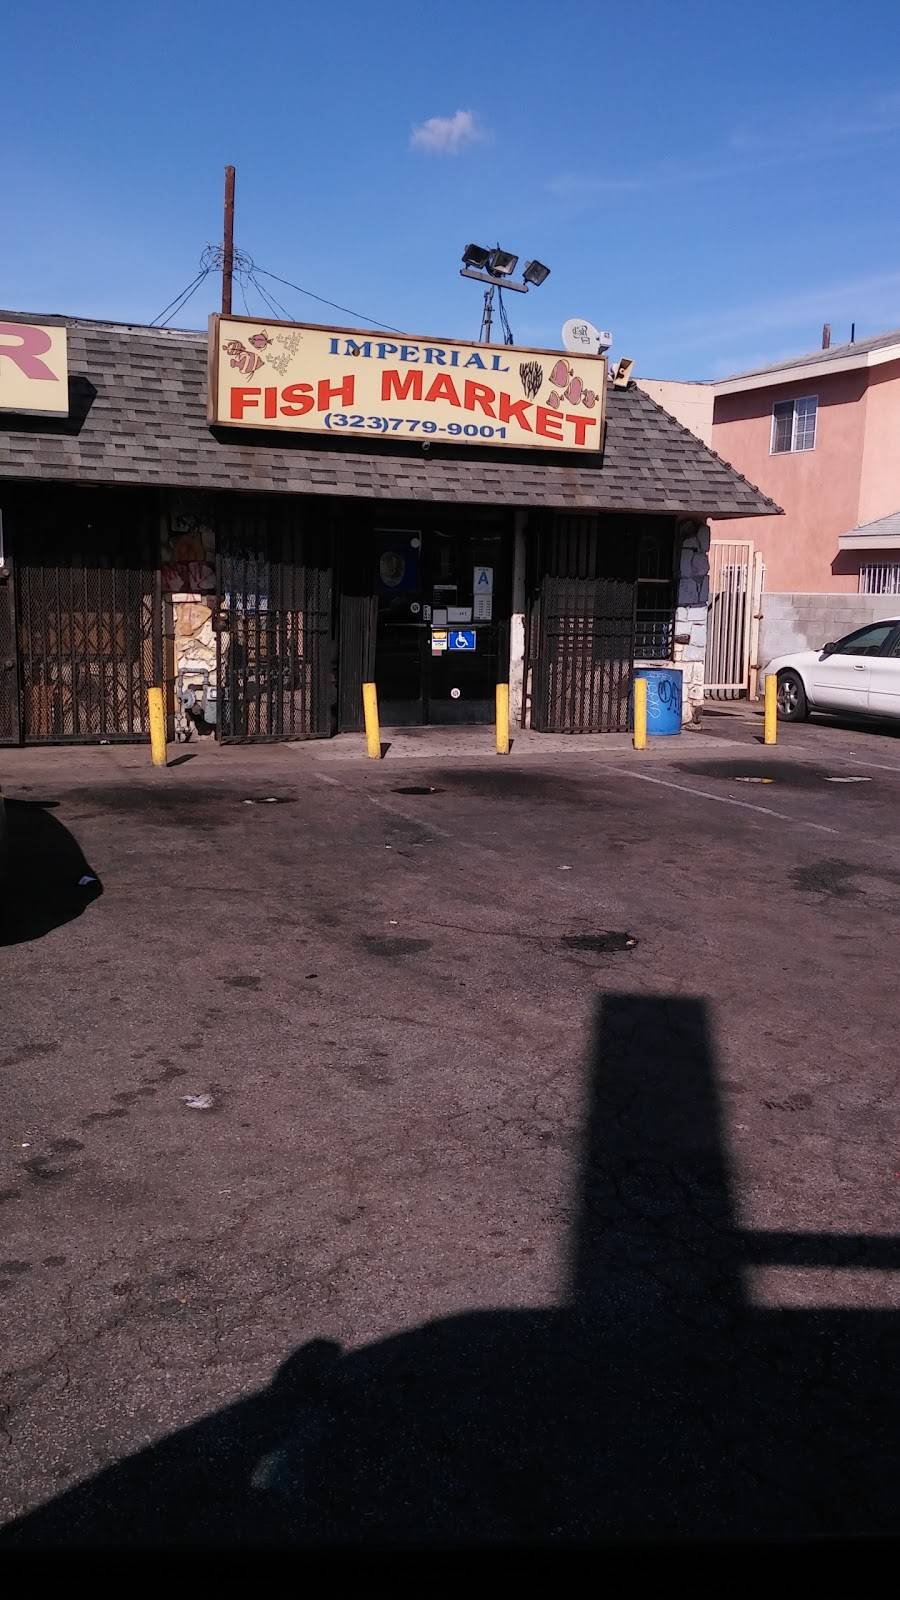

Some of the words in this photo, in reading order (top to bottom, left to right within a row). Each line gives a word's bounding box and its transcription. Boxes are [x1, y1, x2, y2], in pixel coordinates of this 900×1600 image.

[328, 337, 510, 372] IMPERIAL
[230, 374, 355, 420] FISH
[381, 369, 597, 446] MARKET
[324, 412, 507, 440] (323)779-9001
[478, 571, 489, 585] A
